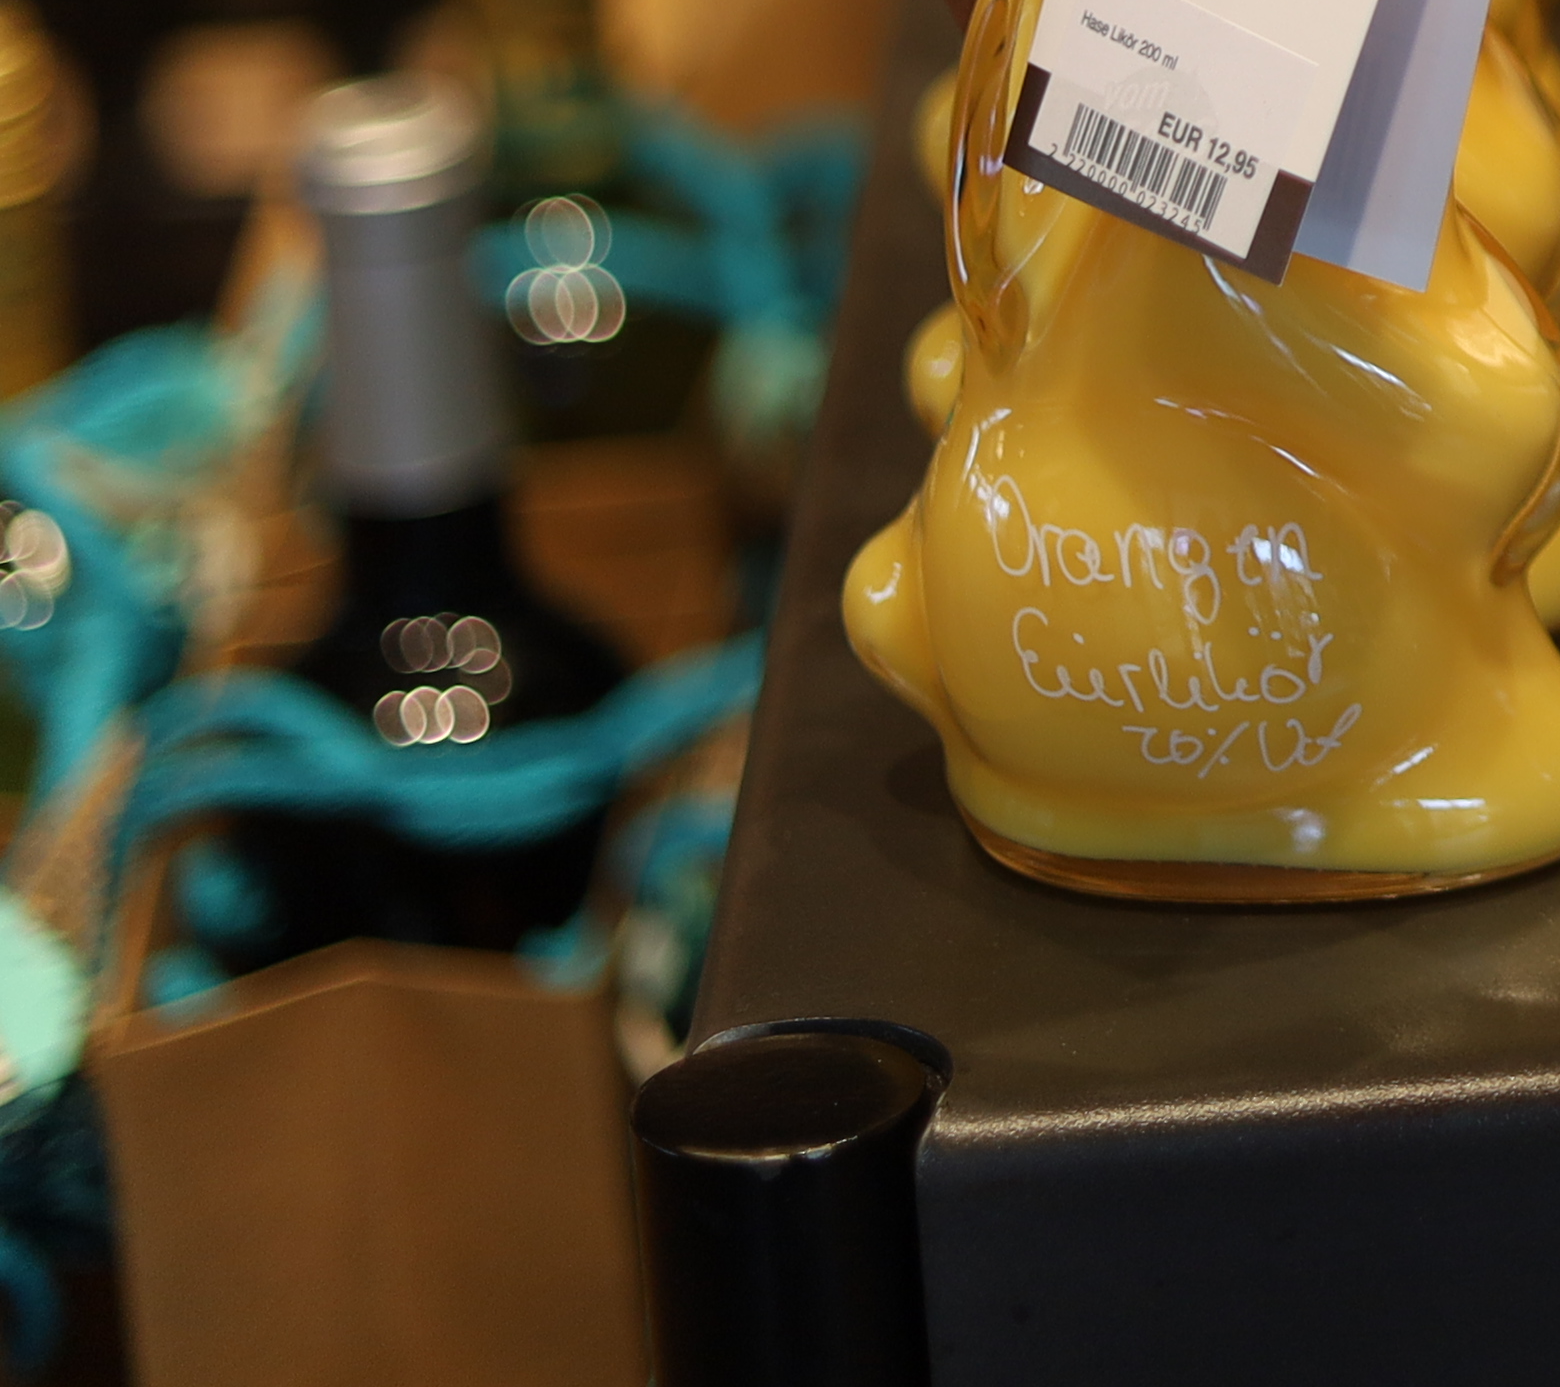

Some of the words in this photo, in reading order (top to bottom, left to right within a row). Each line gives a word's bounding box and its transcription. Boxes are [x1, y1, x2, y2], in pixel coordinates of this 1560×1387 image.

[1080, 9, 1110, 37] Hase
[1110, 24, 1139, 52] Likör
[1137, 39, 1163, 64] 200
[1161, 55, 1180, 71] ml
[1156, 110, 1204, 154] EUR
[1206, 136, 1261, 181] 12,95
[1065, 152, 1129, 197] 220000
[1135, 189, 1204, 235] 023245
[1010, 606, 1335, 711] Eierlikör
